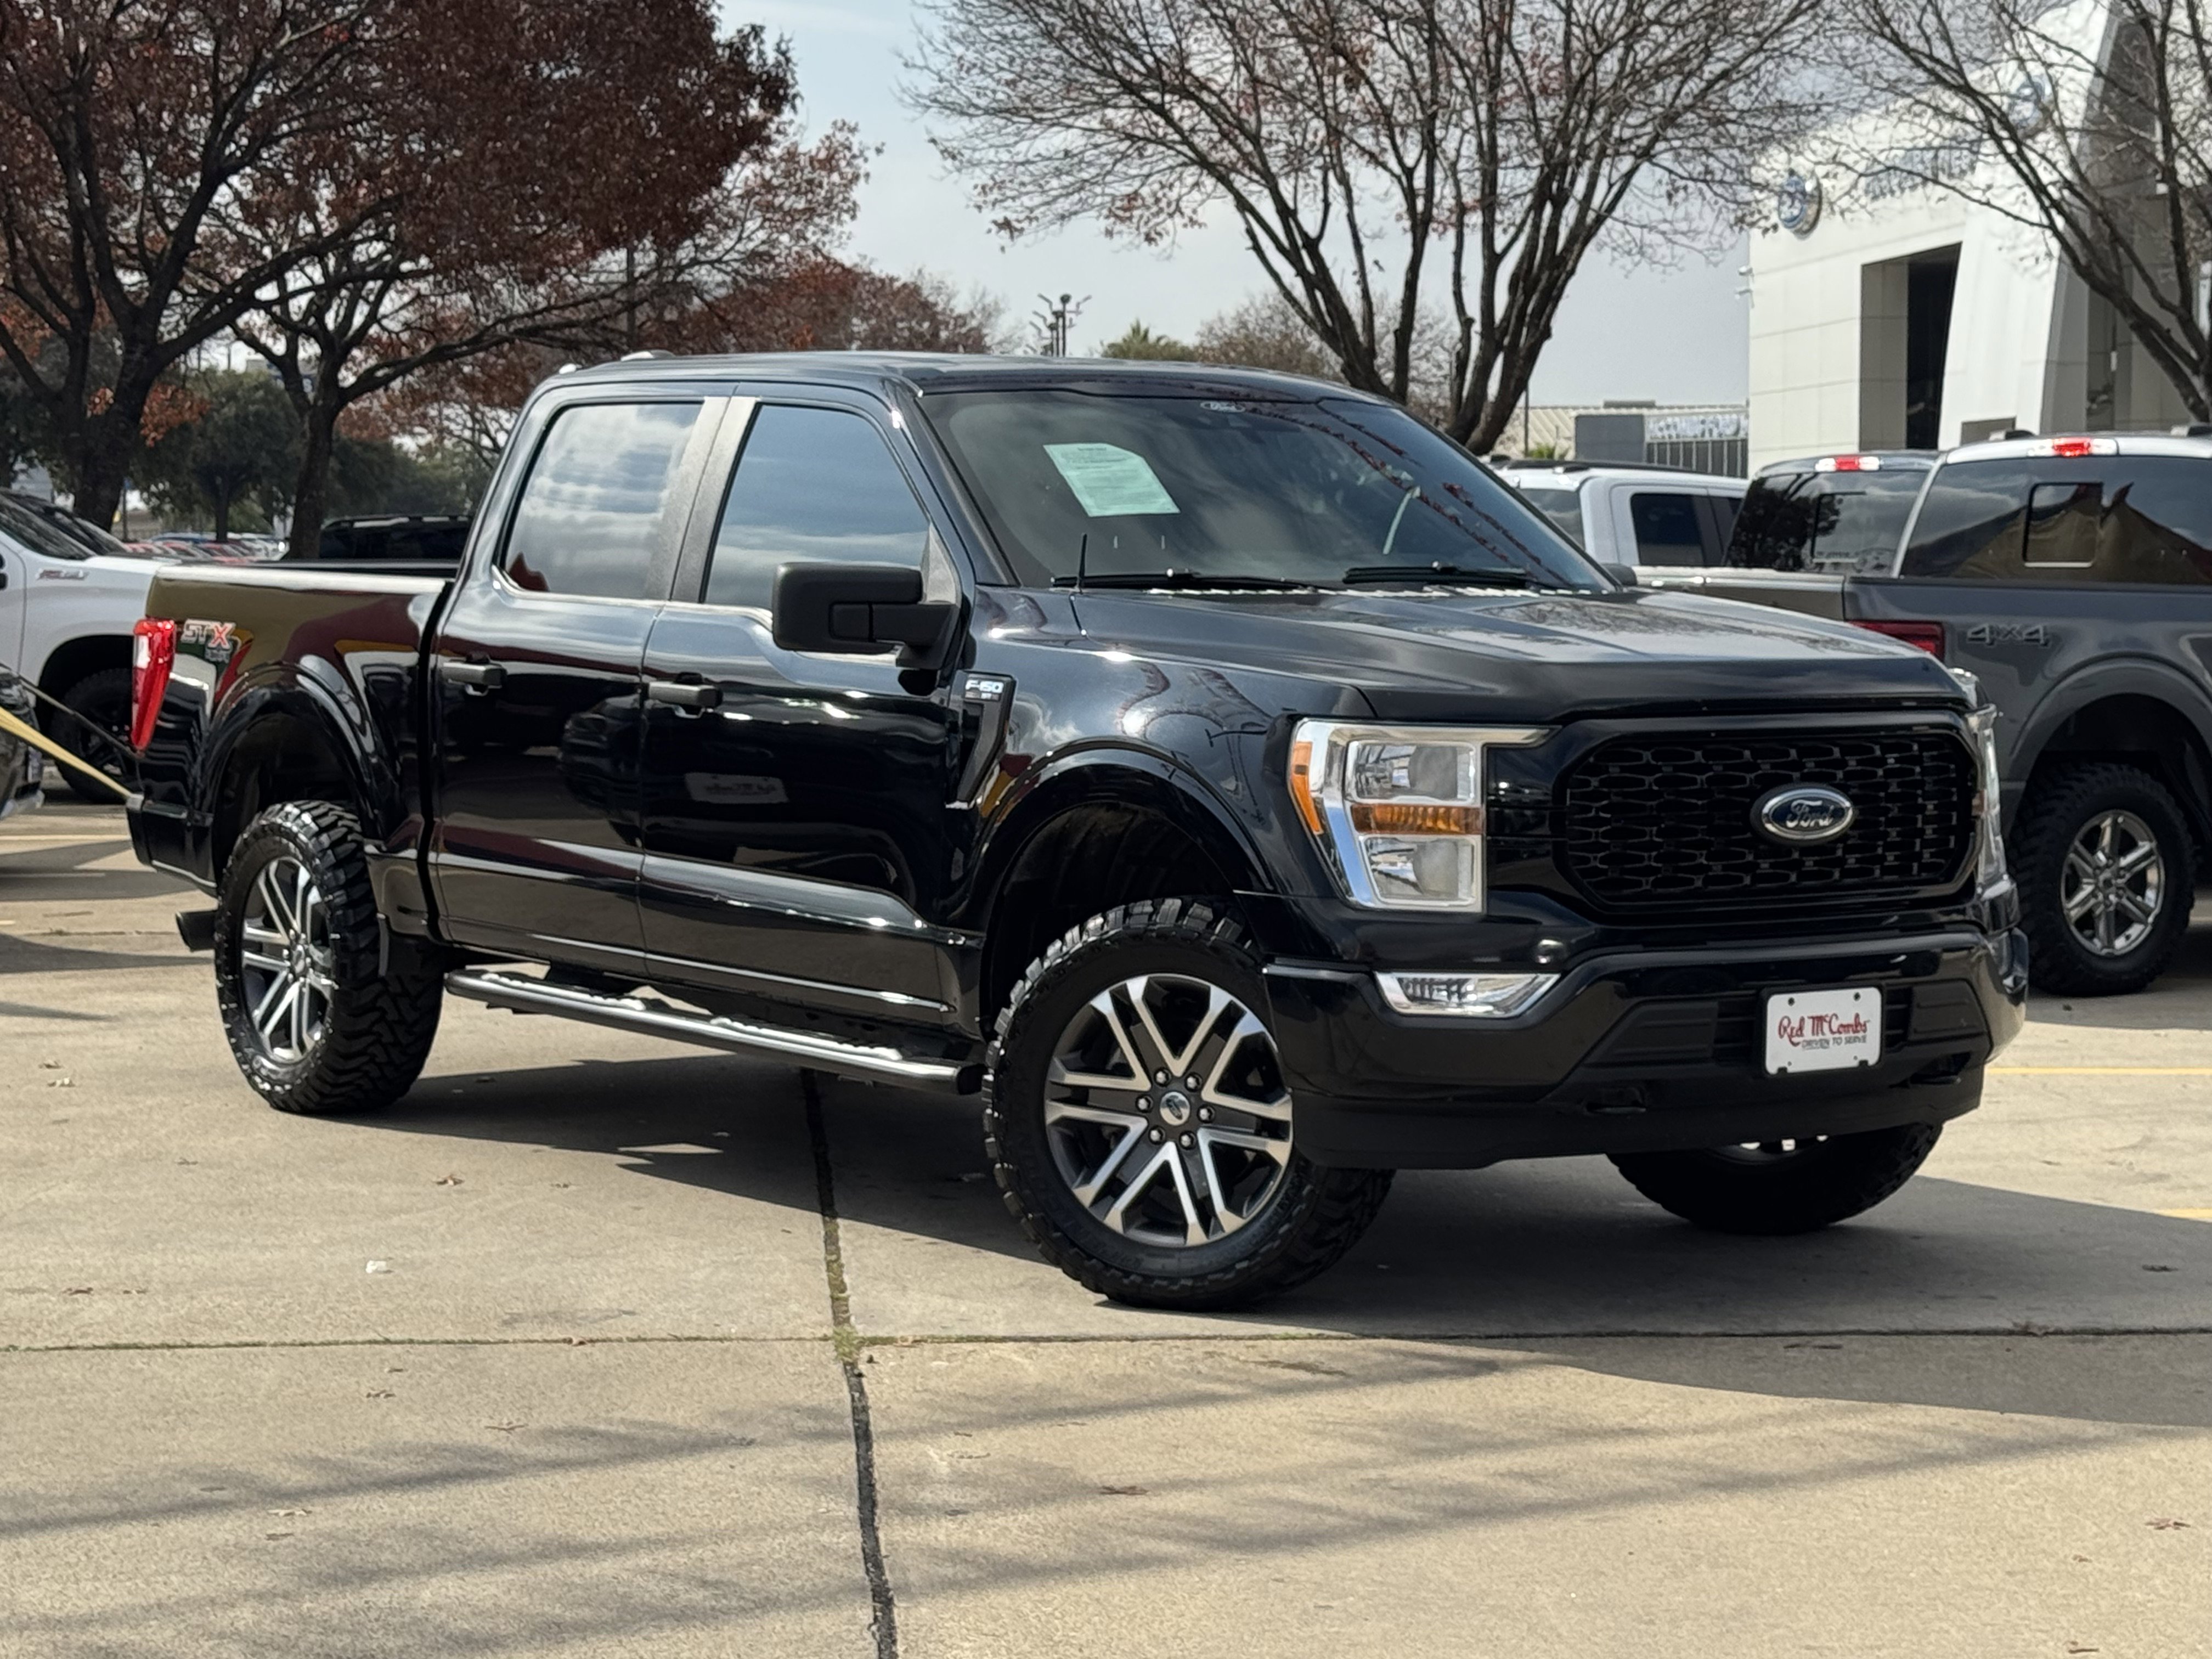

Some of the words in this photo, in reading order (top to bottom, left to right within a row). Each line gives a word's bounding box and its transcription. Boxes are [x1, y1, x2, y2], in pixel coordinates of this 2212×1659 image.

[181, 619, 236, 648] STX
[1786, 799, 1834, 827] Ford
[1779, 1015, 1805, 1047] Red
